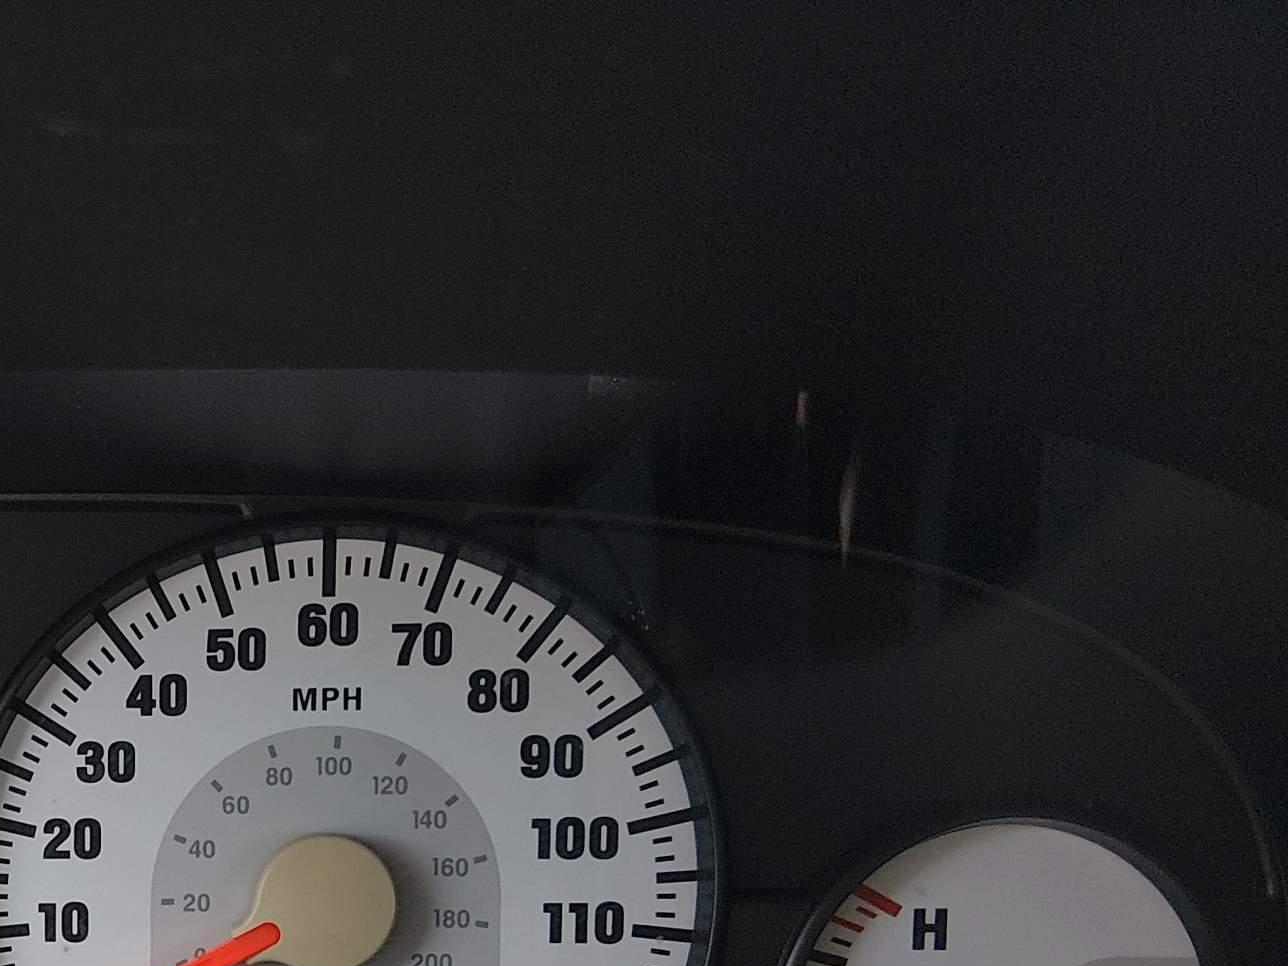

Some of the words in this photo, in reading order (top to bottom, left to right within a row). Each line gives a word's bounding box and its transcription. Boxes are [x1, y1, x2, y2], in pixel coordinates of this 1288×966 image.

[298, 603, 358, 647] 60
[392, 622, 452, 666] 70
[207, 628, 266, 671] 50
[126, 674, 187, 716] 40
[293, 687, 361, 711] MPH
[468, 669, 529, 713] 80
[77, 741, 135, 783] 30
[266, 767, 292, 785] 80
[317, 757, 351, 775] 100
[520, 735, 583, 778] 90
[223, 796, 249, 814] 60
[373, 776, 408, 795] 120
[43, 818, 101, 859] 20
[413, 810, 446, 829] 140
[532, 817, 618, 860] 100
[189, 840, 215, 858] 40
[432, 858, 468, 876] 160
[39, 902, 88, 943] 10
[184, 894, 210, 912] 20
[433, 909, 469, 928] 180
[543, 902, 624, 944] 110
[913, 909, 947, 950] H
